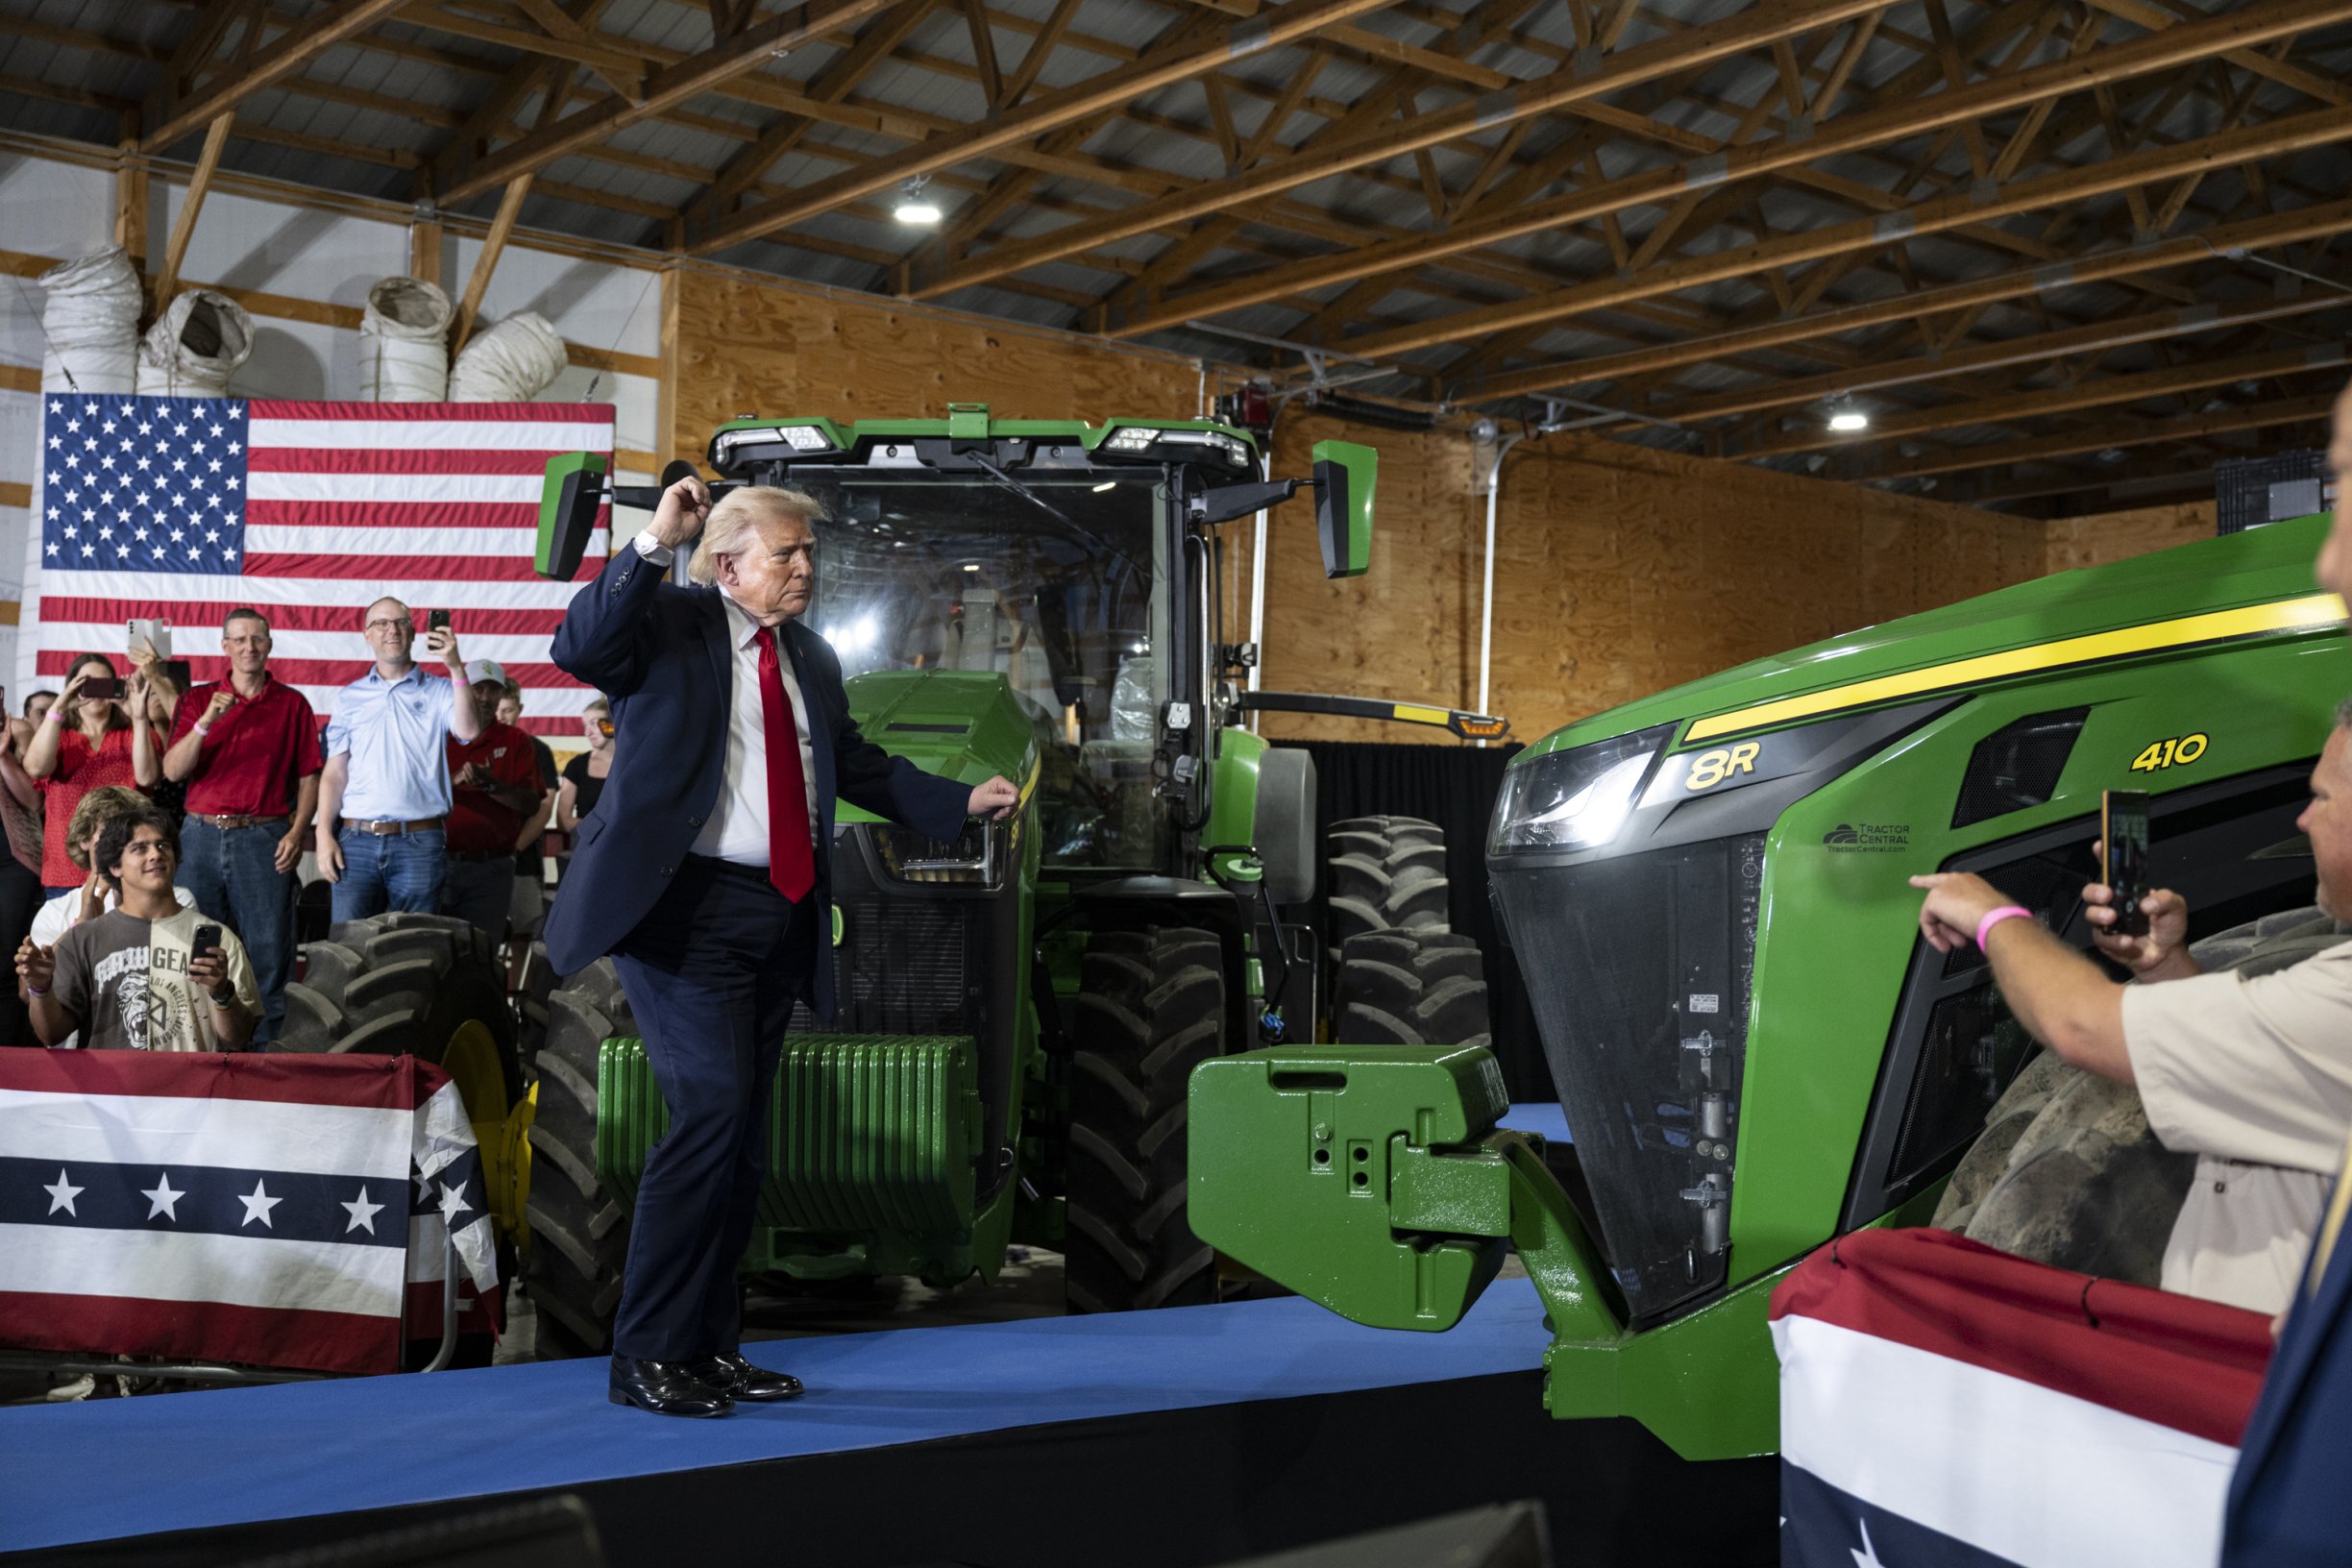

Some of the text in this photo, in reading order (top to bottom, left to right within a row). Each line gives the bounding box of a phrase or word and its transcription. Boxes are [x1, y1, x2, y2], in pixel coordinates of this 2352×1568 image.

[1685, 742, 1760, 791] 8R
[2130, 732, 2209, 772] 410
[152, 946, 189, 976] GEA
[165, 982, 188, 1015] ANGELES
